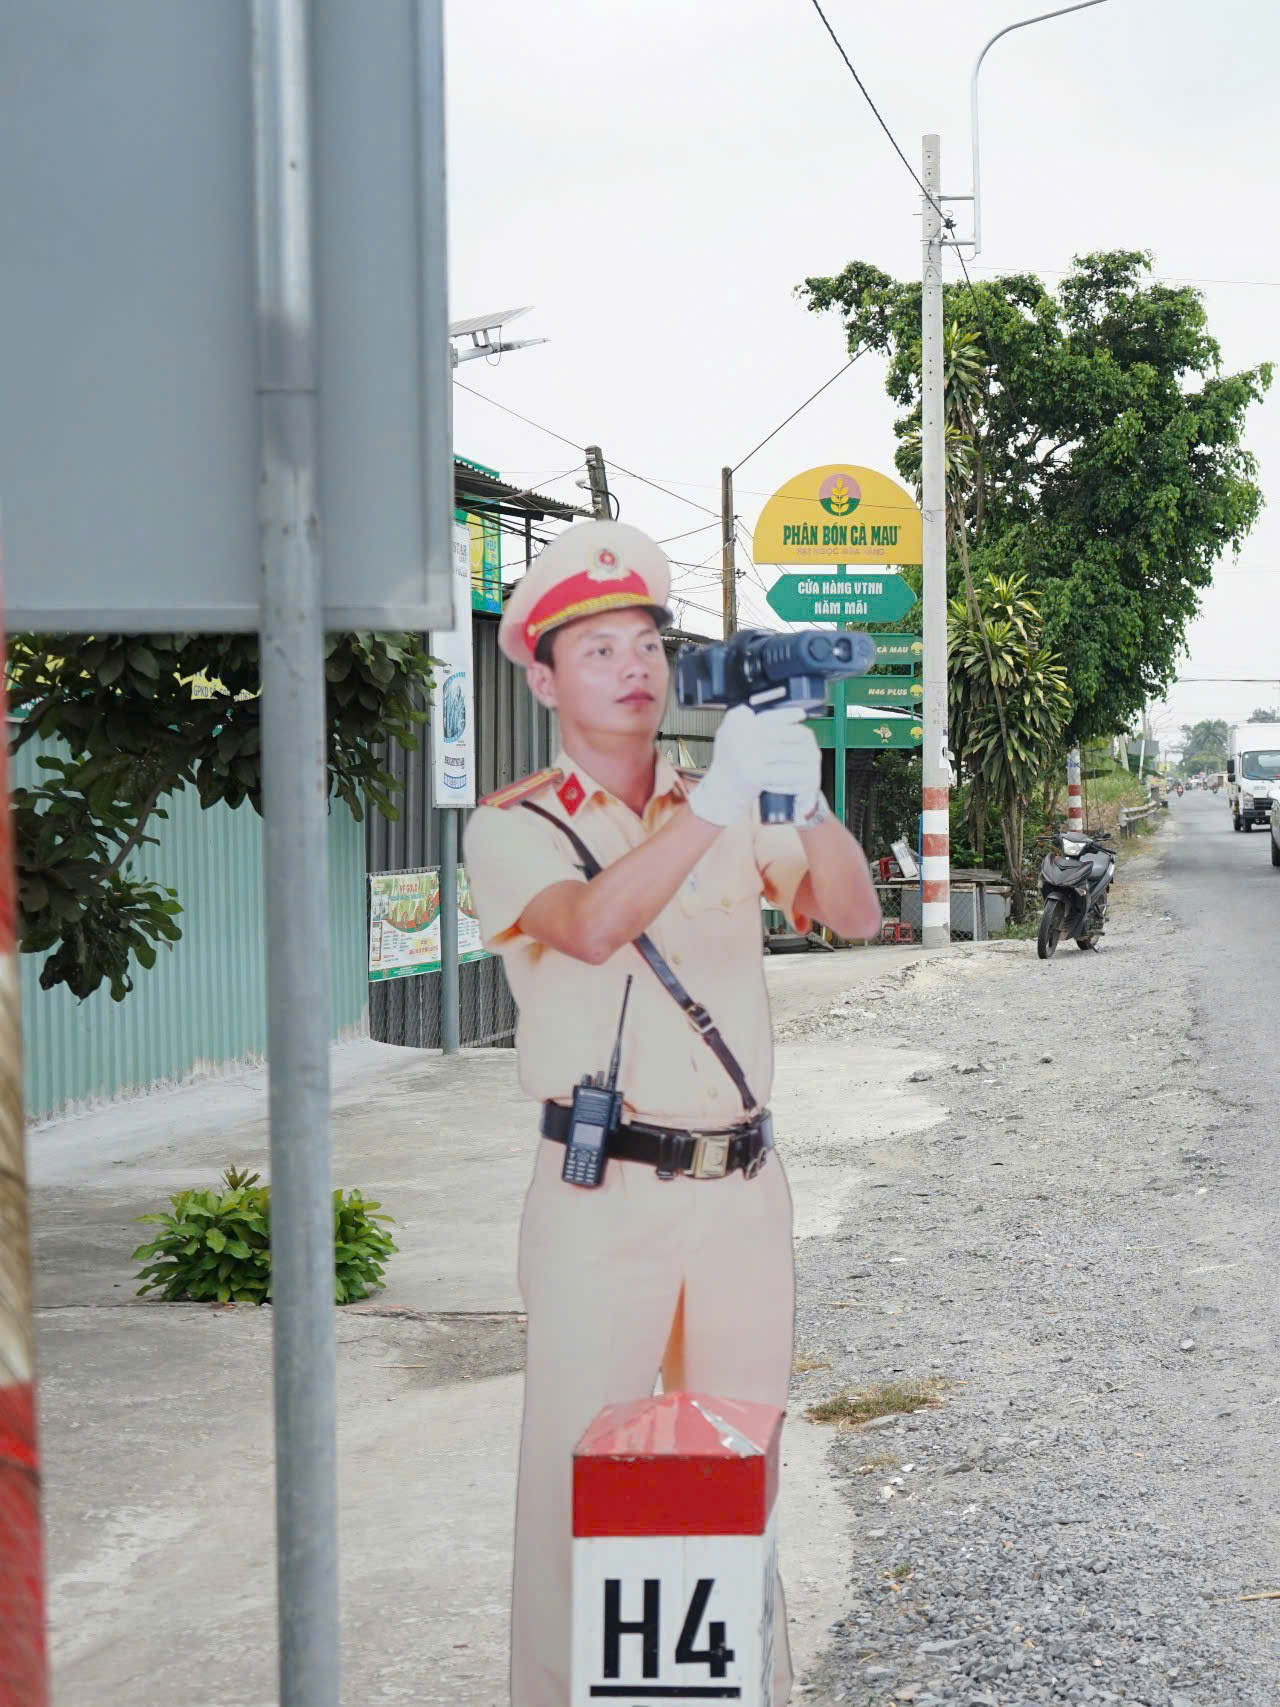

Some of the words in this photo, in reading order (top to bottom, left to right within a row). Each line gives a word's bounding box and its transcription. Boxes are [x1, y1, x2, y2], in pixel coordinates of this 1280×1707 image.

[783, 522, 818, 545] PHÂN
[822, 521, 847, 545] BÓN
[850, 522, 867, 545] CÀ
[871, 525, 898, 545] MAU
[798, 579, 819, 595] CỬA
[822, 580, 852, 595] HÀNG
[854, 582, 883, 595] VTNN
[814, 600, 840, 615] NĂM
[844, 600, 867, 615] MÃI
[876, 645, 888, 653] CÀ
[887, 688, 908, 696] PLUS
[603, 1578, 735, 1680] H4
